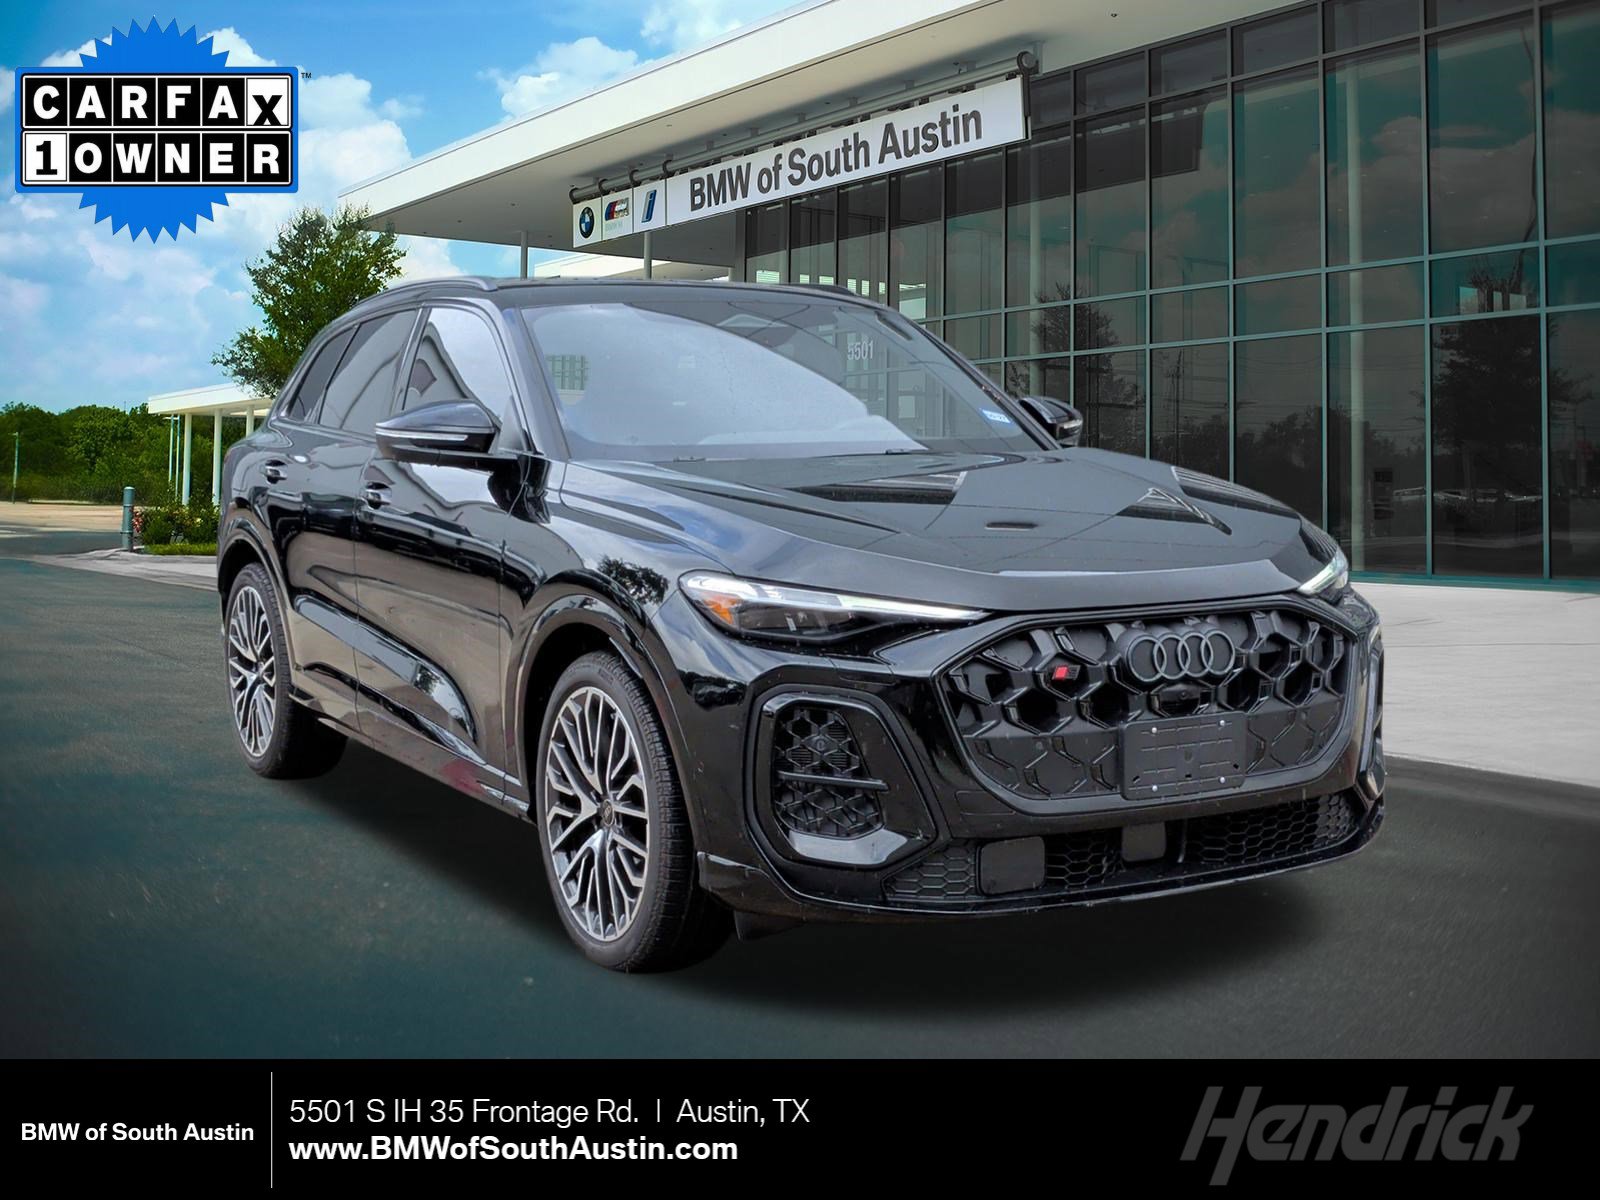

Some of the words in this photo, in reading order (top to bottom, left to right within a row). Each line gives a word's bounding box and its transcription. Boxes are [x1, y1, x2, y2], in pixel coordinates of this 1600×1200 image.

[690, 163, 752, 212] BMW
[757, 153, 783, 194] of
[788, 132, 871, 186] South
[878, 104, 982, 164] Austin
